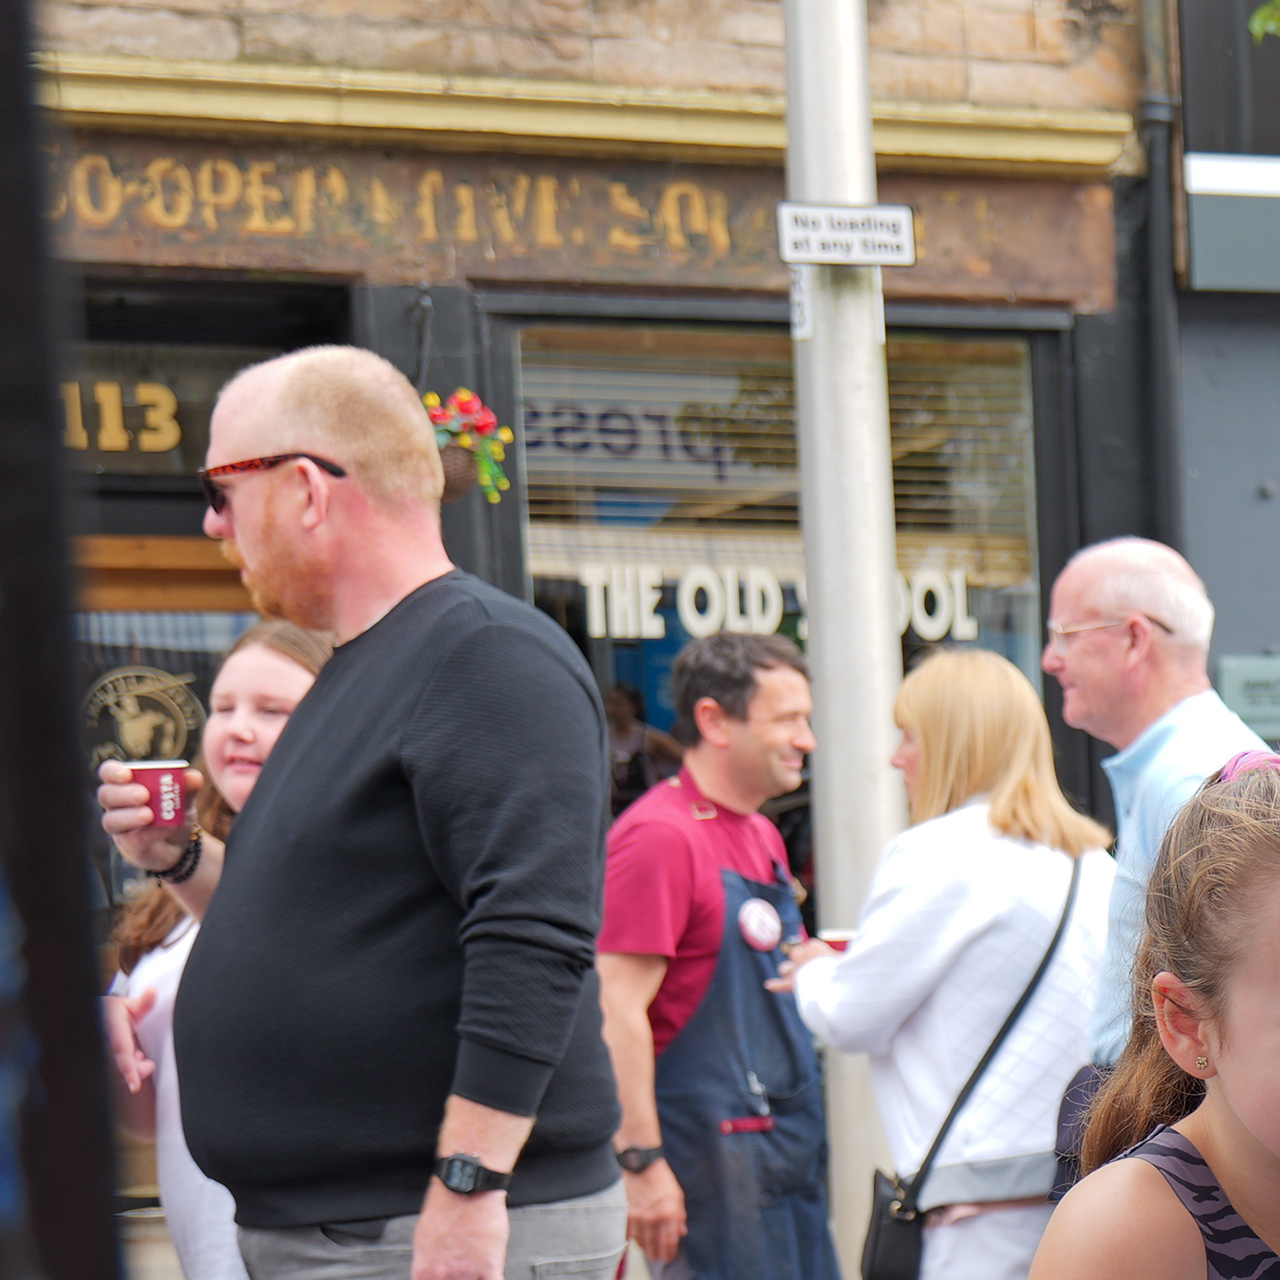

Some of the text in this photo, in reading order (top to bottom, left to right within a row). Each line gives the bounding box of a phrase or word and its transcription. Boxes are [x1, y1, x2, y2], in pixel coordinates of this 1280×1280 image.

[793, 214, 900, 234] No loading
[793, 236, 904, 257] at any time
[62, 379, 182, 453] 113
[580, 564, 666, 639] THE
[676, 563, 784, 638] OLD
[160, 773, 175, 821] COSTA
